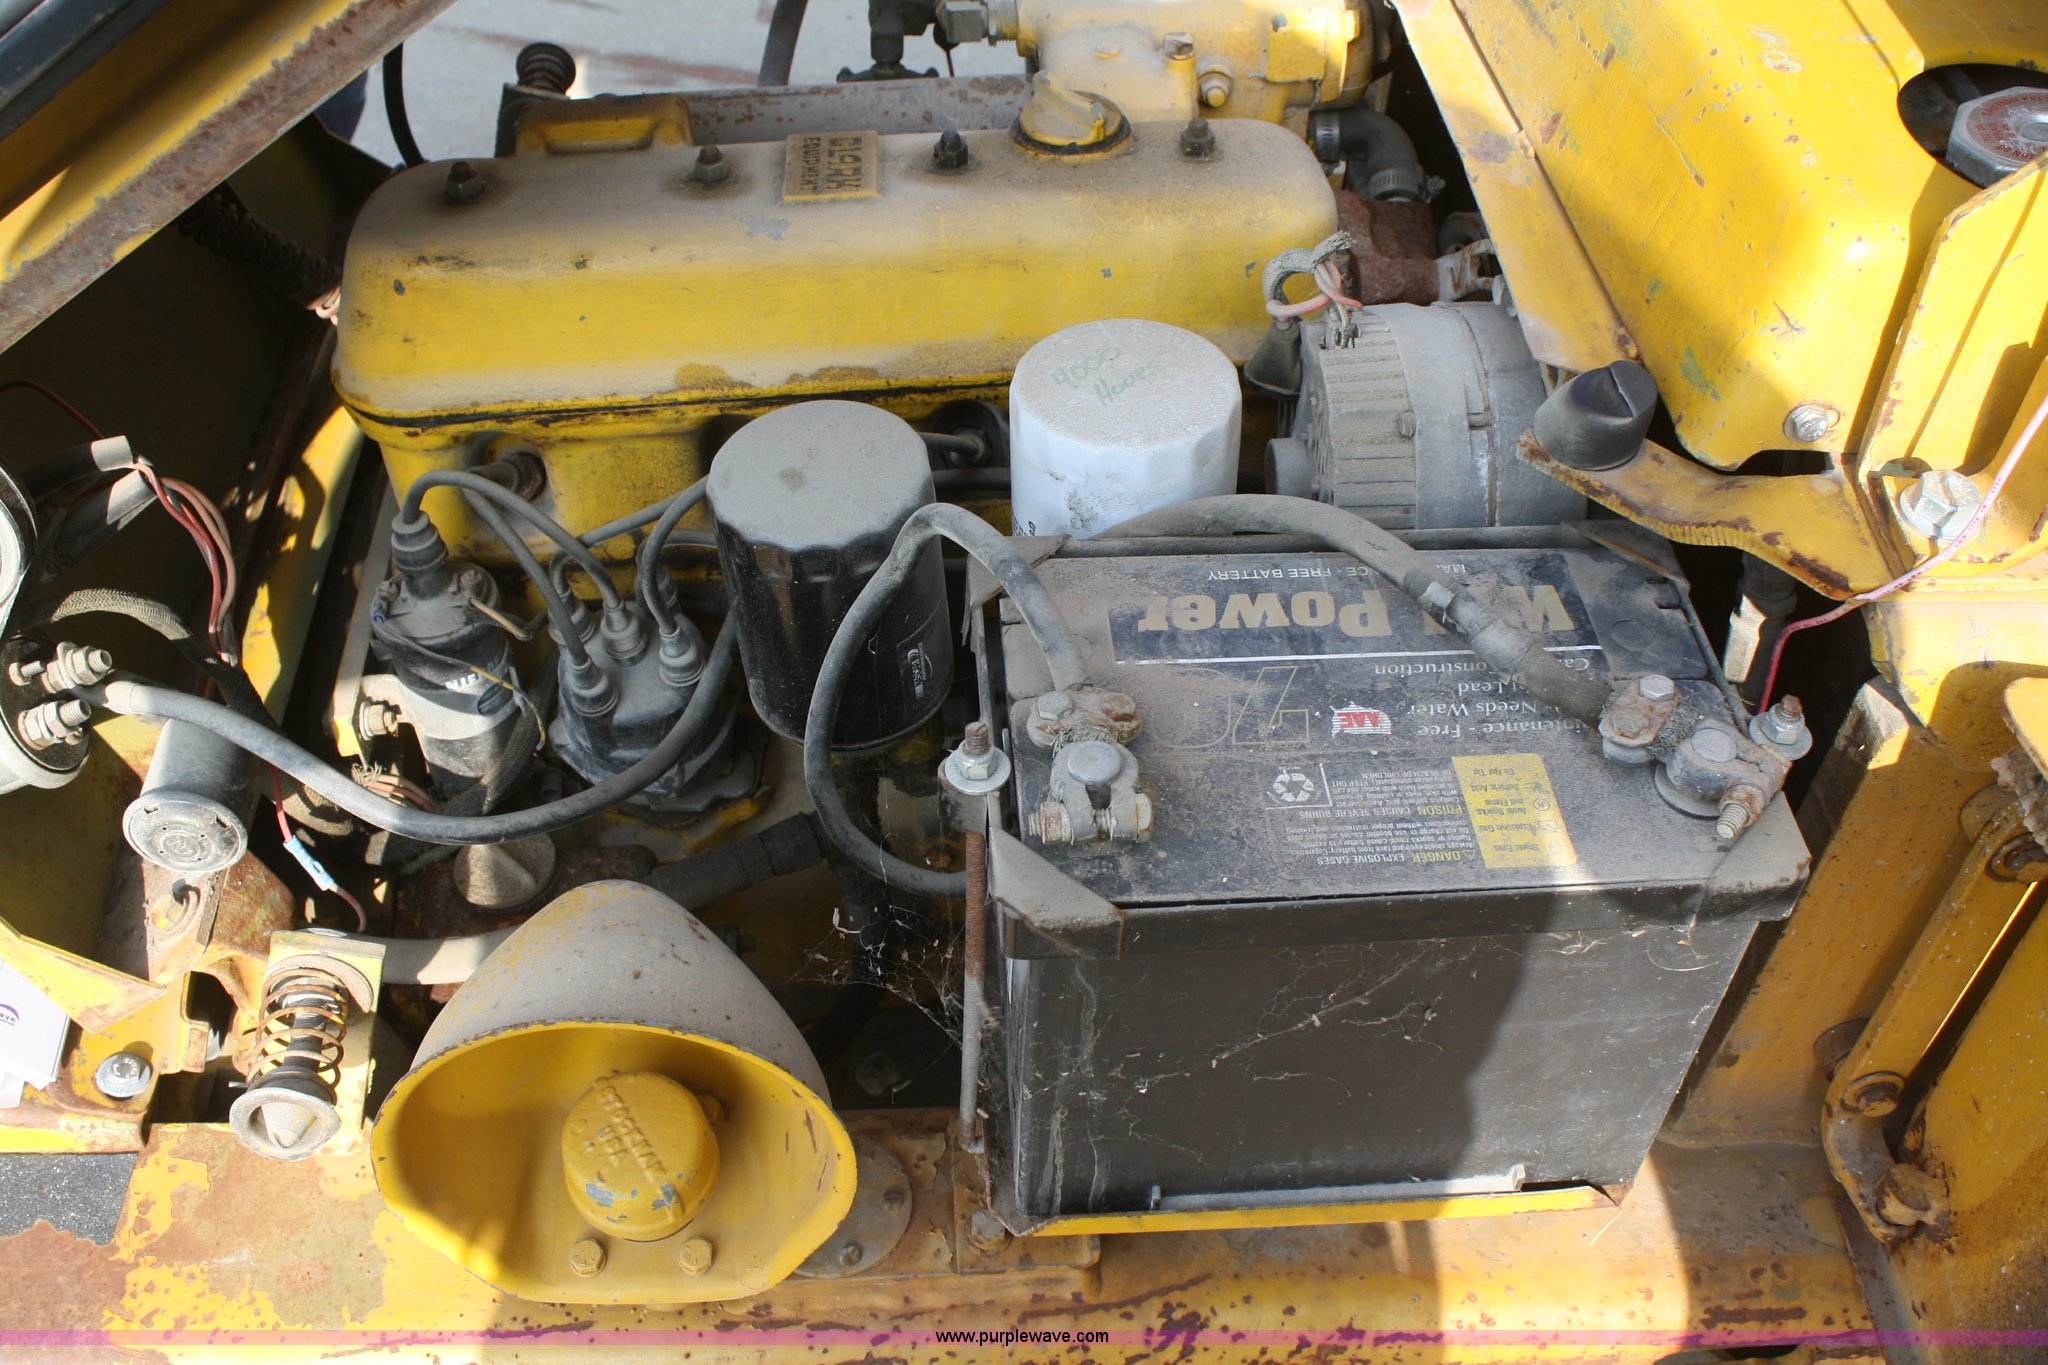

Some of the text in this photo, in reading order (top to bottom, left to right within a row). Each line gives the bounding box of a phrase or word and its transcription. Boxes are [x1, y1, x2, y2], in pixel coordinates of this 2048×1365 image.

[800, 136, 821, 192] EQUIPMENT
[826, 136, 862, 190] CLARK
[1206, 566, 1283, 580] BATTERY
[1286, 566, 1331, 578] FREE
[1135, 588, 1393, 636] Power
[1374, 660, 1487, 678] onstruction
[1456, 680, 1502, 696] Lead
[1406, 702, 1468, 716] Water
[1474, 700, 1536, 716] Needs
[1334, 710, 1379, 728] AAE
[1416, 722, 1460, 738] Free
[1297, 804, 1462, 818] POISON CAUSES SEVERE BURNS
[1316, 850, 1460, 864] DANGER EXPLOSIVE GASES
